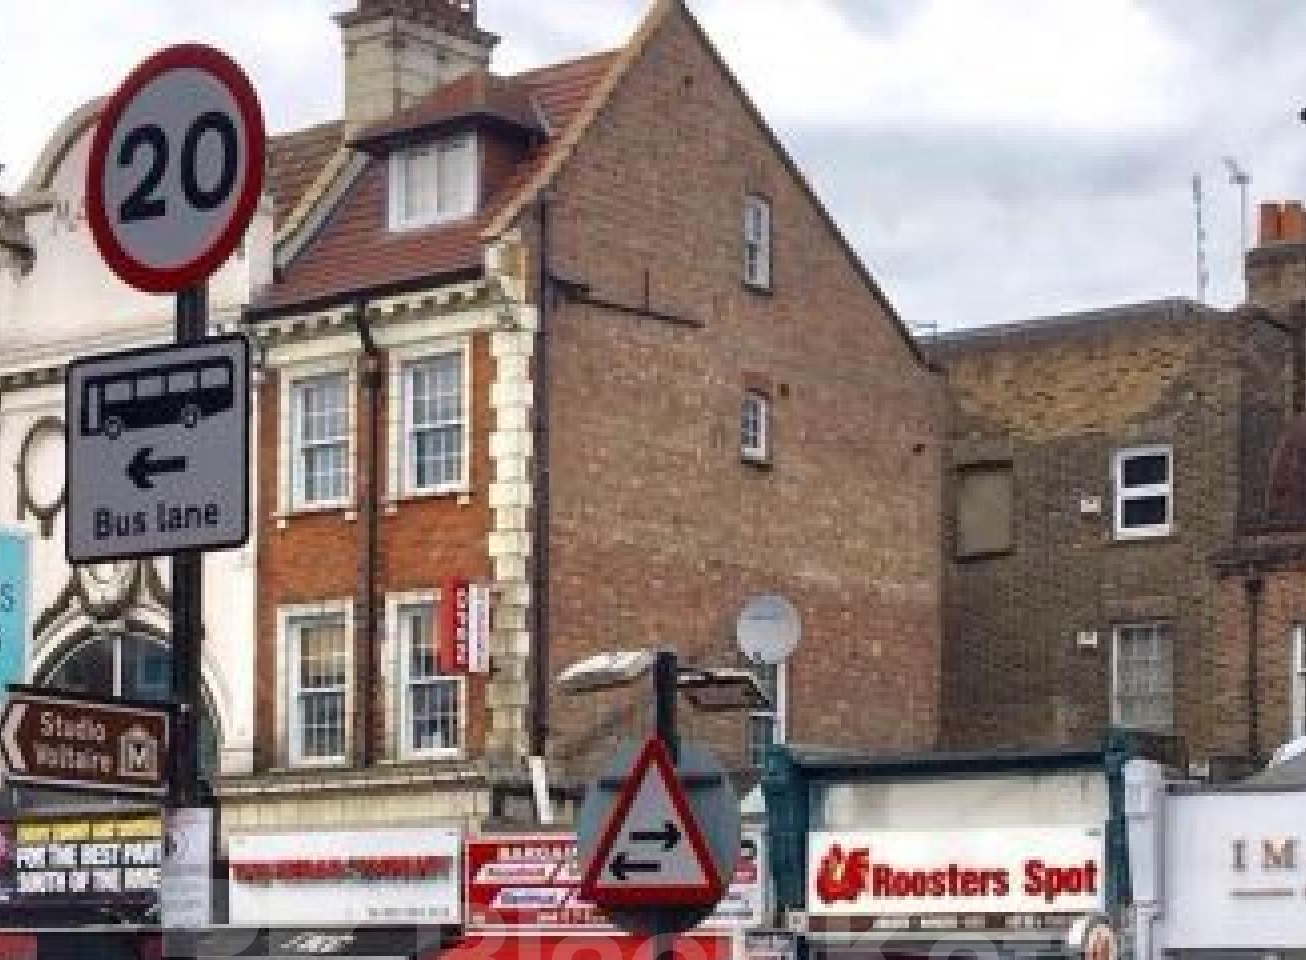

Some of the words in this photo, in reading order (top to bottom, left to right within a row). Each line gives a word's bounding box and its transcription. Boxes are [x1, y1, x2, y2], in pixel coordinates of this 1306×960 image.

[117, 111, 239, 225] 20
[94, 507, 147, 541] Bus
[156, 503, 219, 533] lane
[40, 711, 106, 741] Studio
[872, 863, 1010, 897] Roosters
[1024, 859, 1098, 901] Spot
